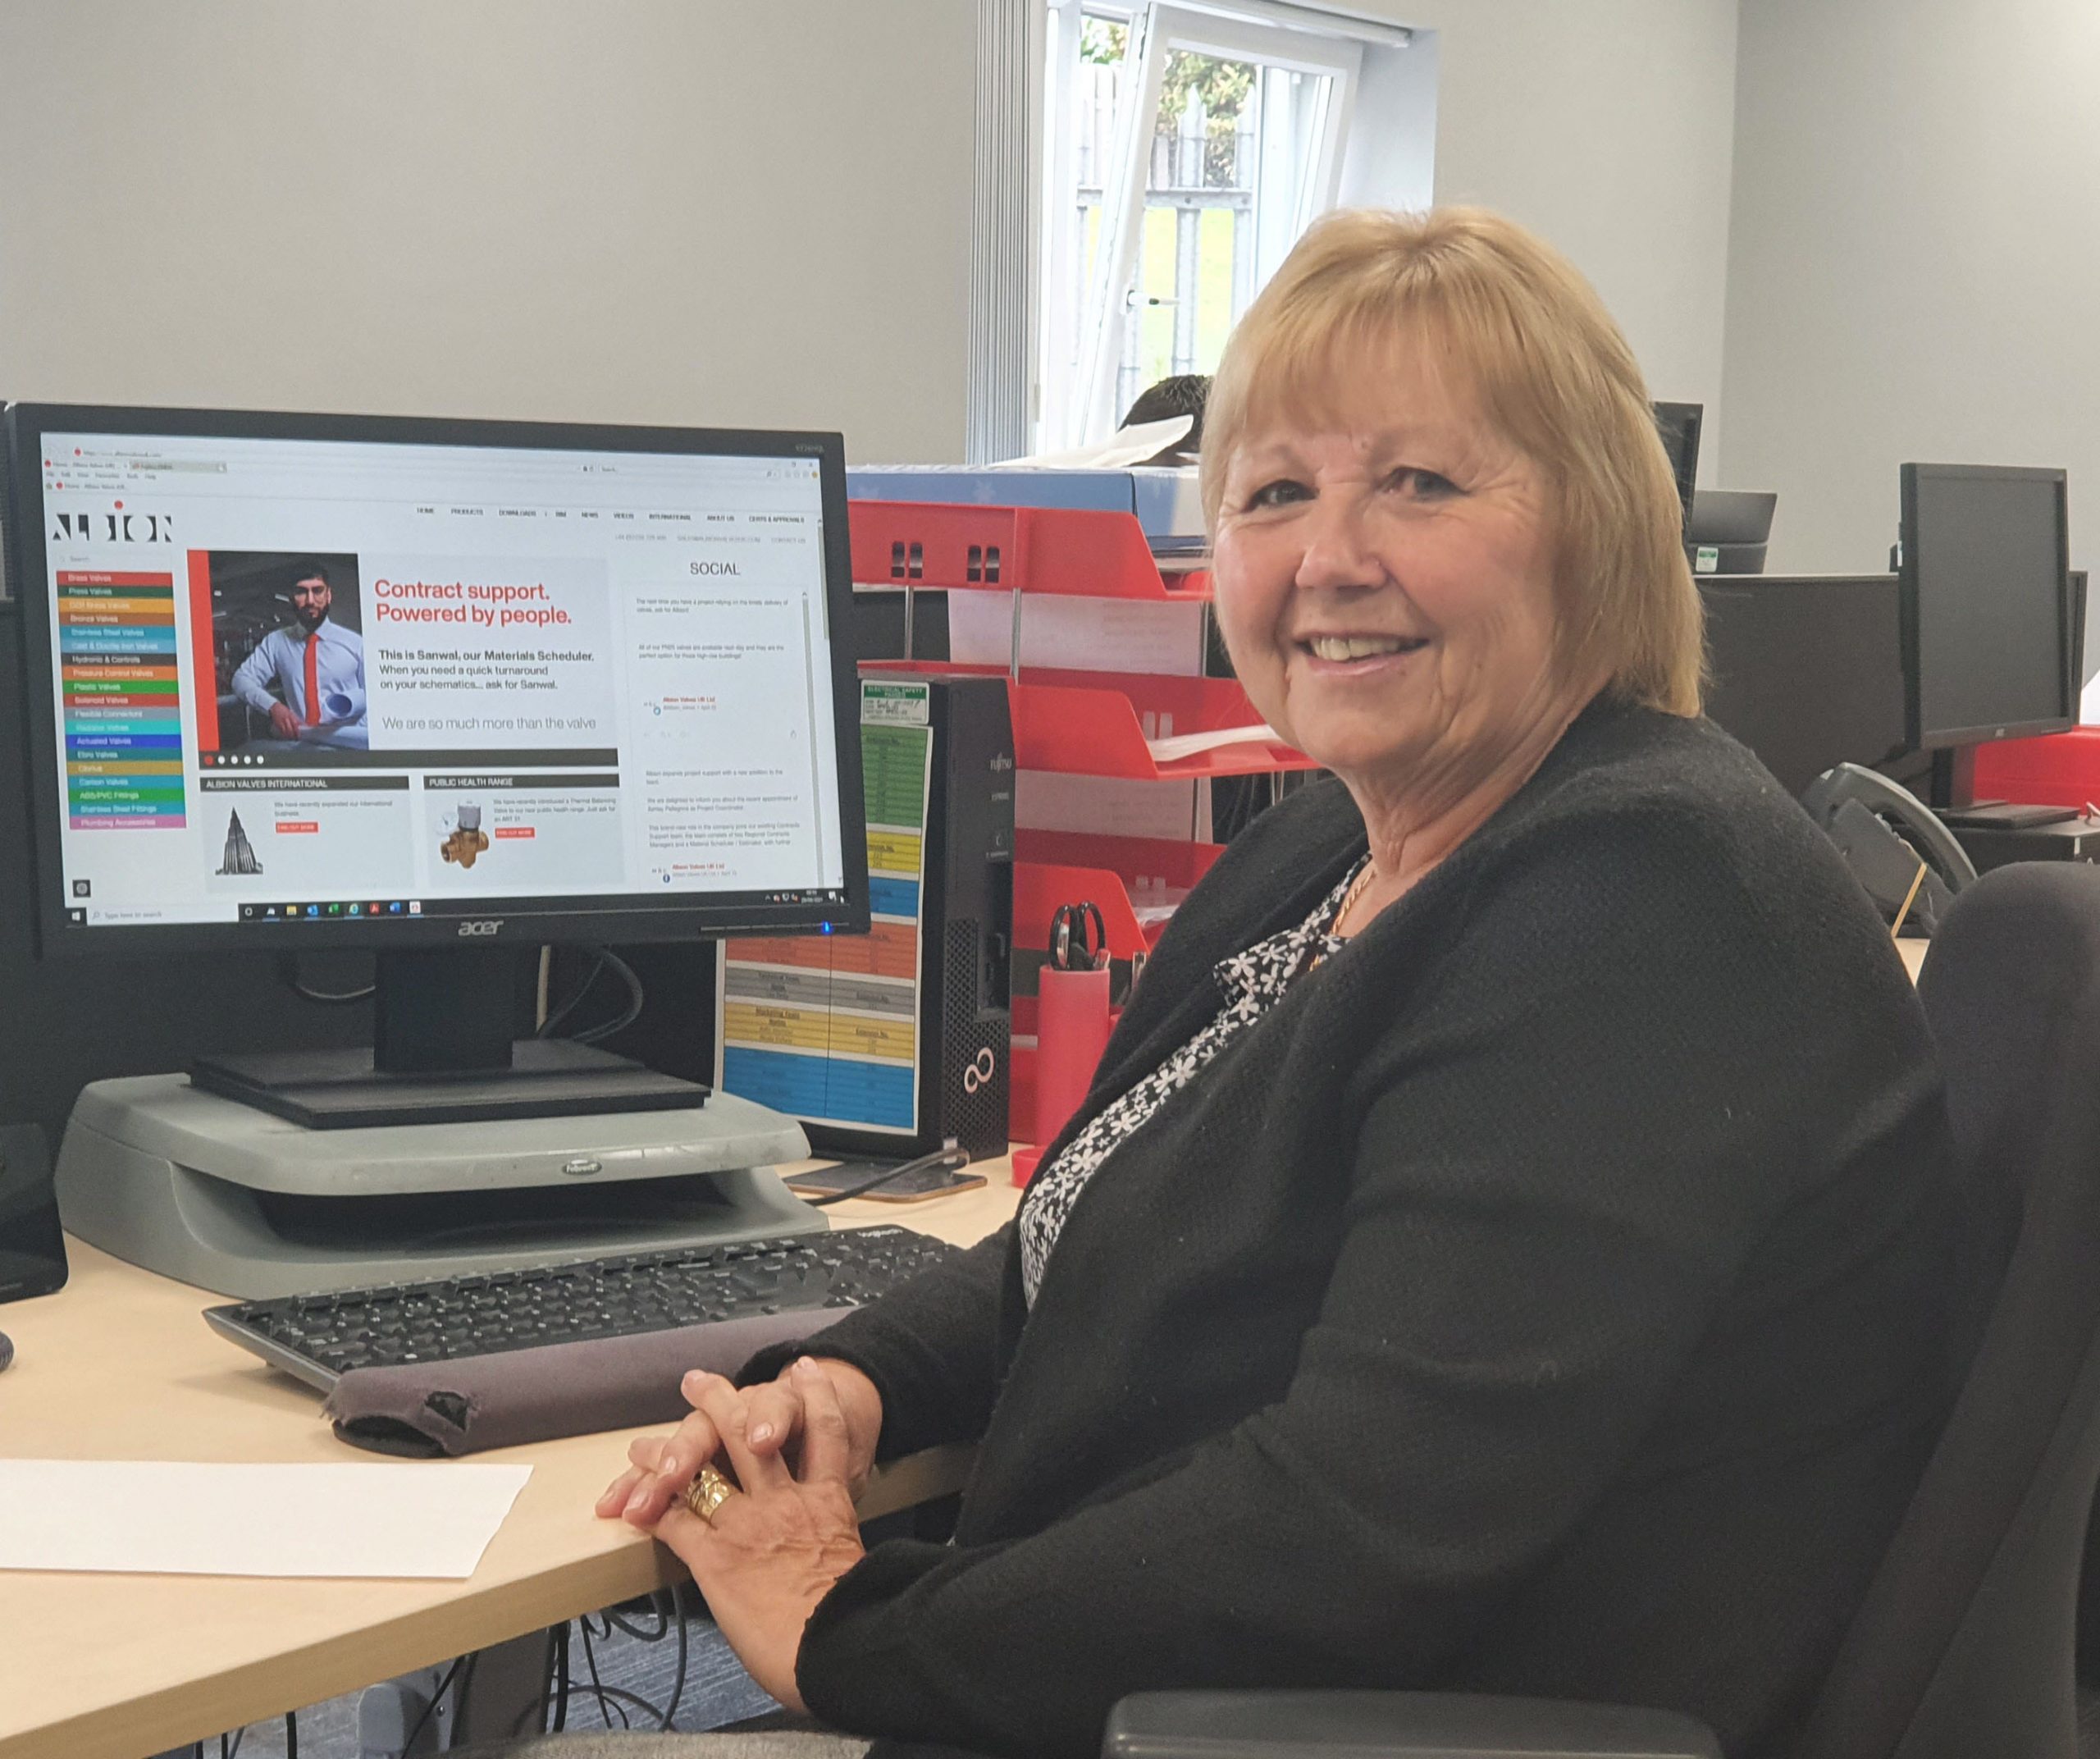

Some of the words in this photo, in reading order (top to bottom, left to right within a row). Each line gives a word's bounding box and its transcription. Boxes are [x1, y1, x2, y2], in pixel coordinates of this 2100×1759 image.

[690, 561, 741, 576] SOCIAL
[375, 578, 463, 598] Contract
[468, 582, 550, 604] support.
[376, 602, 467, 623] Powered
[472, 604, 495, 628] by
[500, 605, 572, 628] people.
[378, 650, 403, 661] This
[405, 650, 415, 660] is
[417, 650, 462, 662] Sanwal,
[463, 652, 482, 661] our
[484, 650, 535, 661] Materials
[537, 651, 595, 662] Scheduler.
[379, 665, 409, 675] When
[411, 667, 429, 678] you
[431, 665, 456, 675] need
[466, 665, 493, 678] quick
[495, 665, 548, 676] turnaround
[380, 682, 394, 690] on
[395, 681, 418, 692] your
[486, 679, 502, 690] ask
[504, 679, 518, 690] for
[520, 679, 558, 690] Sanwal.
[381, 716, 403, 730] We
[406, 720, 426, 730] are
[428, 720, 444, 730] so
[445, 716, 481, 730] much
[482, 719, 514, 730] more
[517, 716, 542, 729] than
[546, 716, 564, 729] the
[566, 716, 597, 729] valve
[206, 779, 235, 788] ALBION
[236, 779, 266, 788] VALVES
[267, 779, 328, 788] INTERNATIONAL
[429, 778, 457, 788] PUBLIC
[457, 778, 486, 787] HEALTH
[487, 778, 514, 786] RANGE
[458, 920, 504, 935] acer
